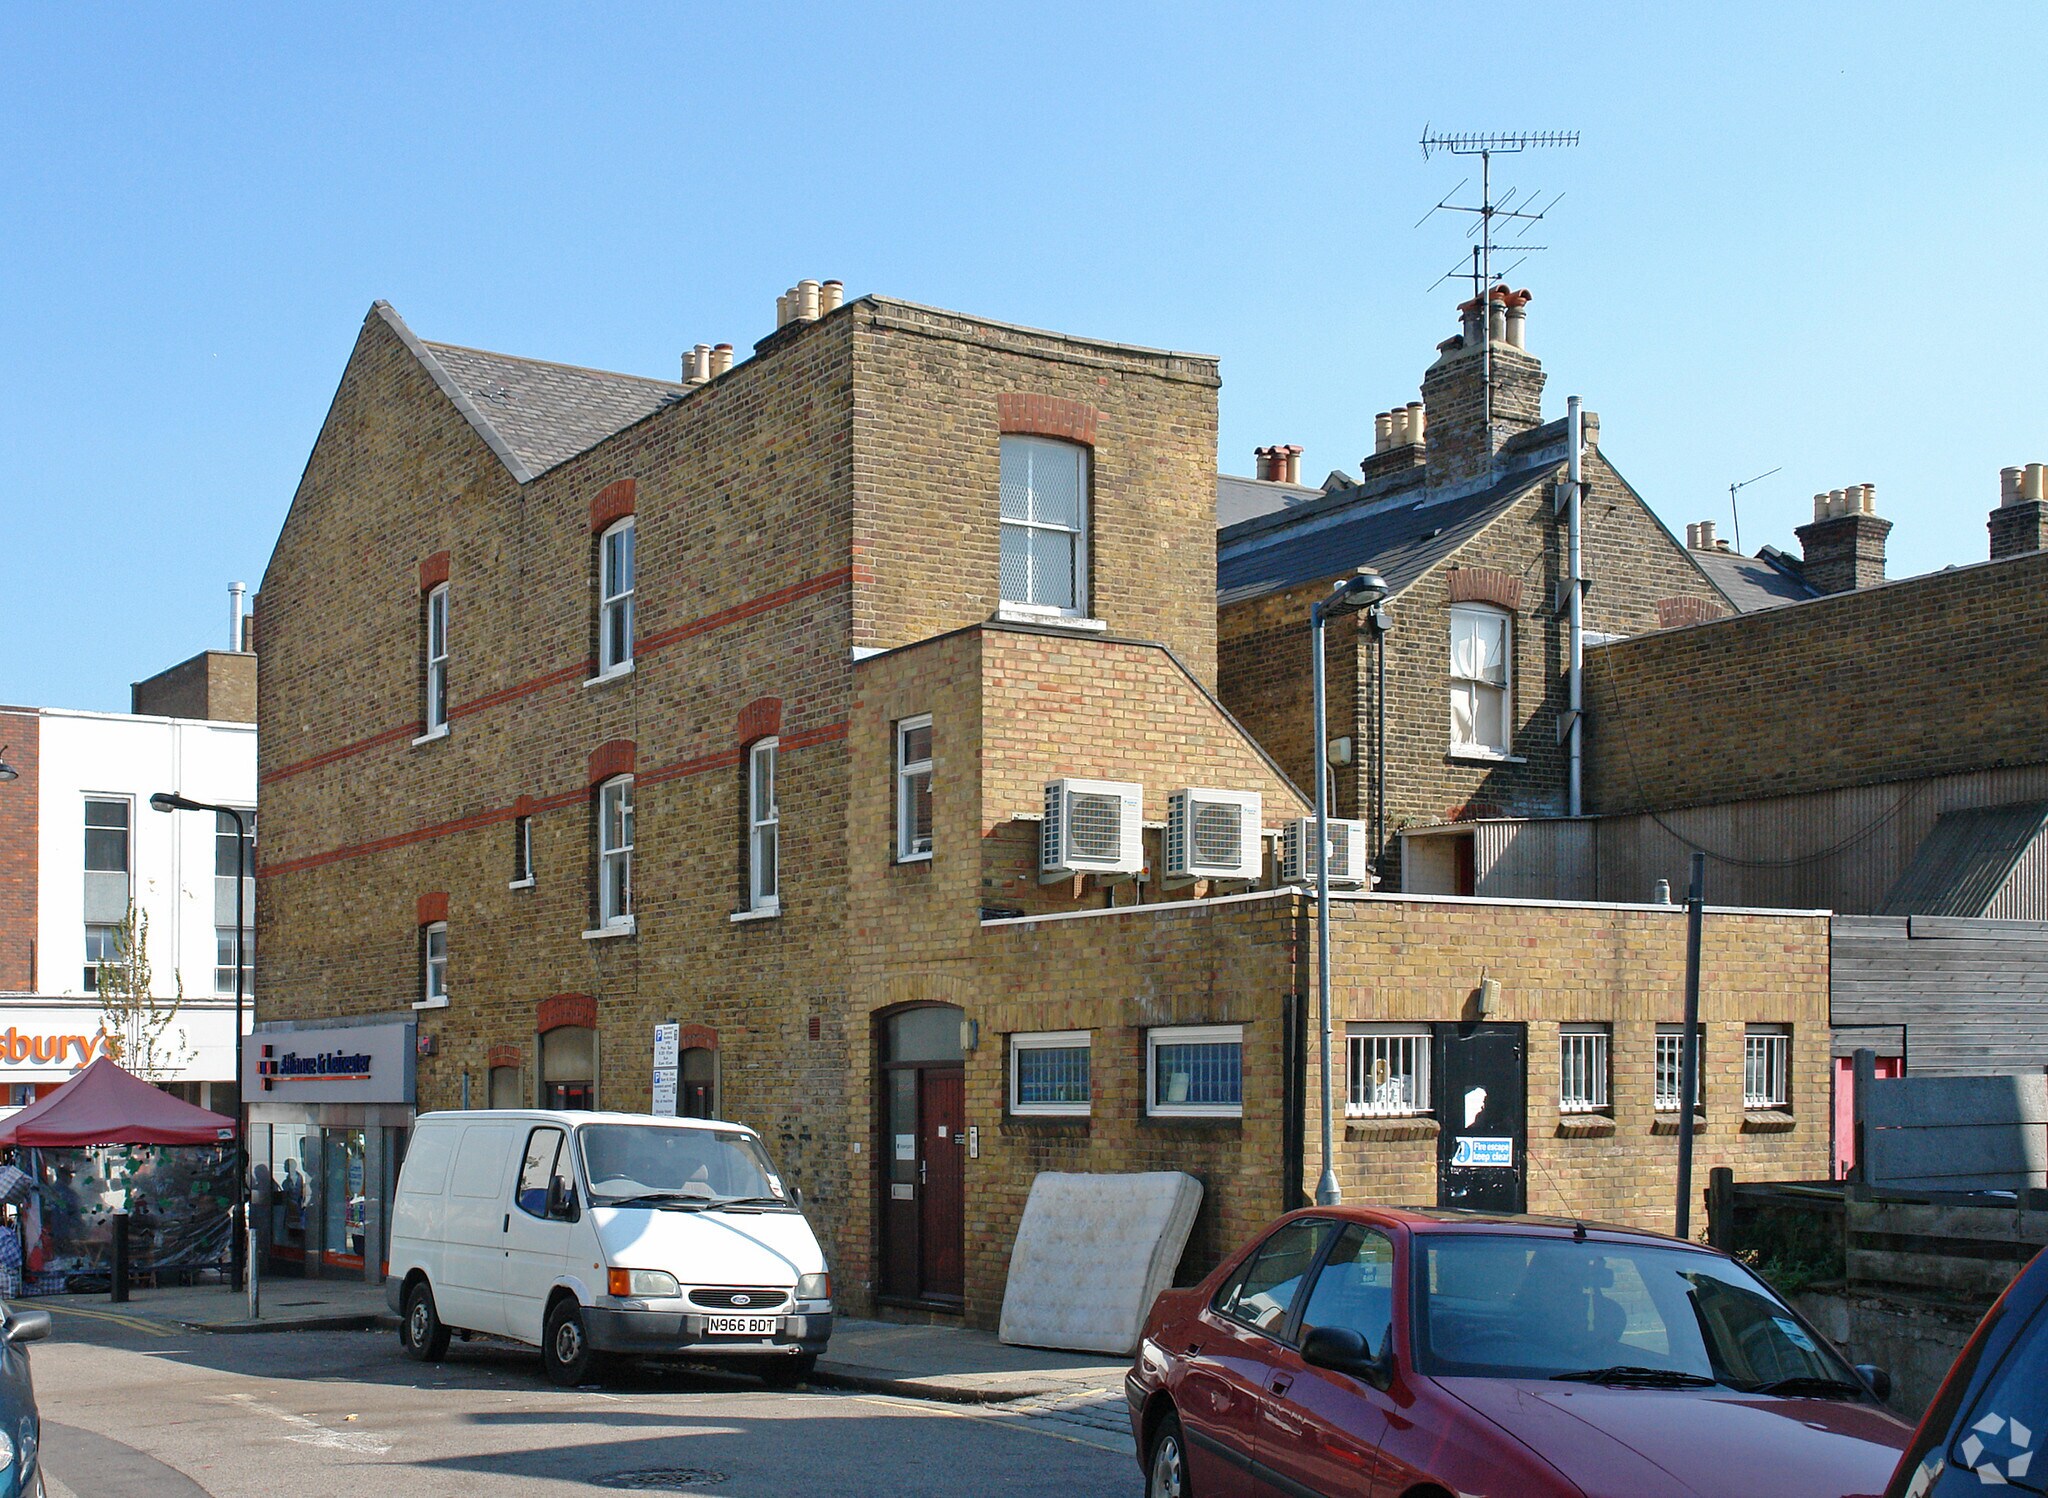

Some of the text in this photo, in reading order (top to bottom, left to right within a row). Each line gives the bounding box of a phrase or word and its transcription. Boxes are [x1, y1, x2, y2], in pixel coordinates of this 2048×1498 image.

[280, 1050, 371, 1075] Alliance & Leicester
[1474, 1142, 1509, 1152] Fire escape
[1474, 1152, 1509, 1162] keep clear
[710, 1318, 775, 1332] N966 BDT
